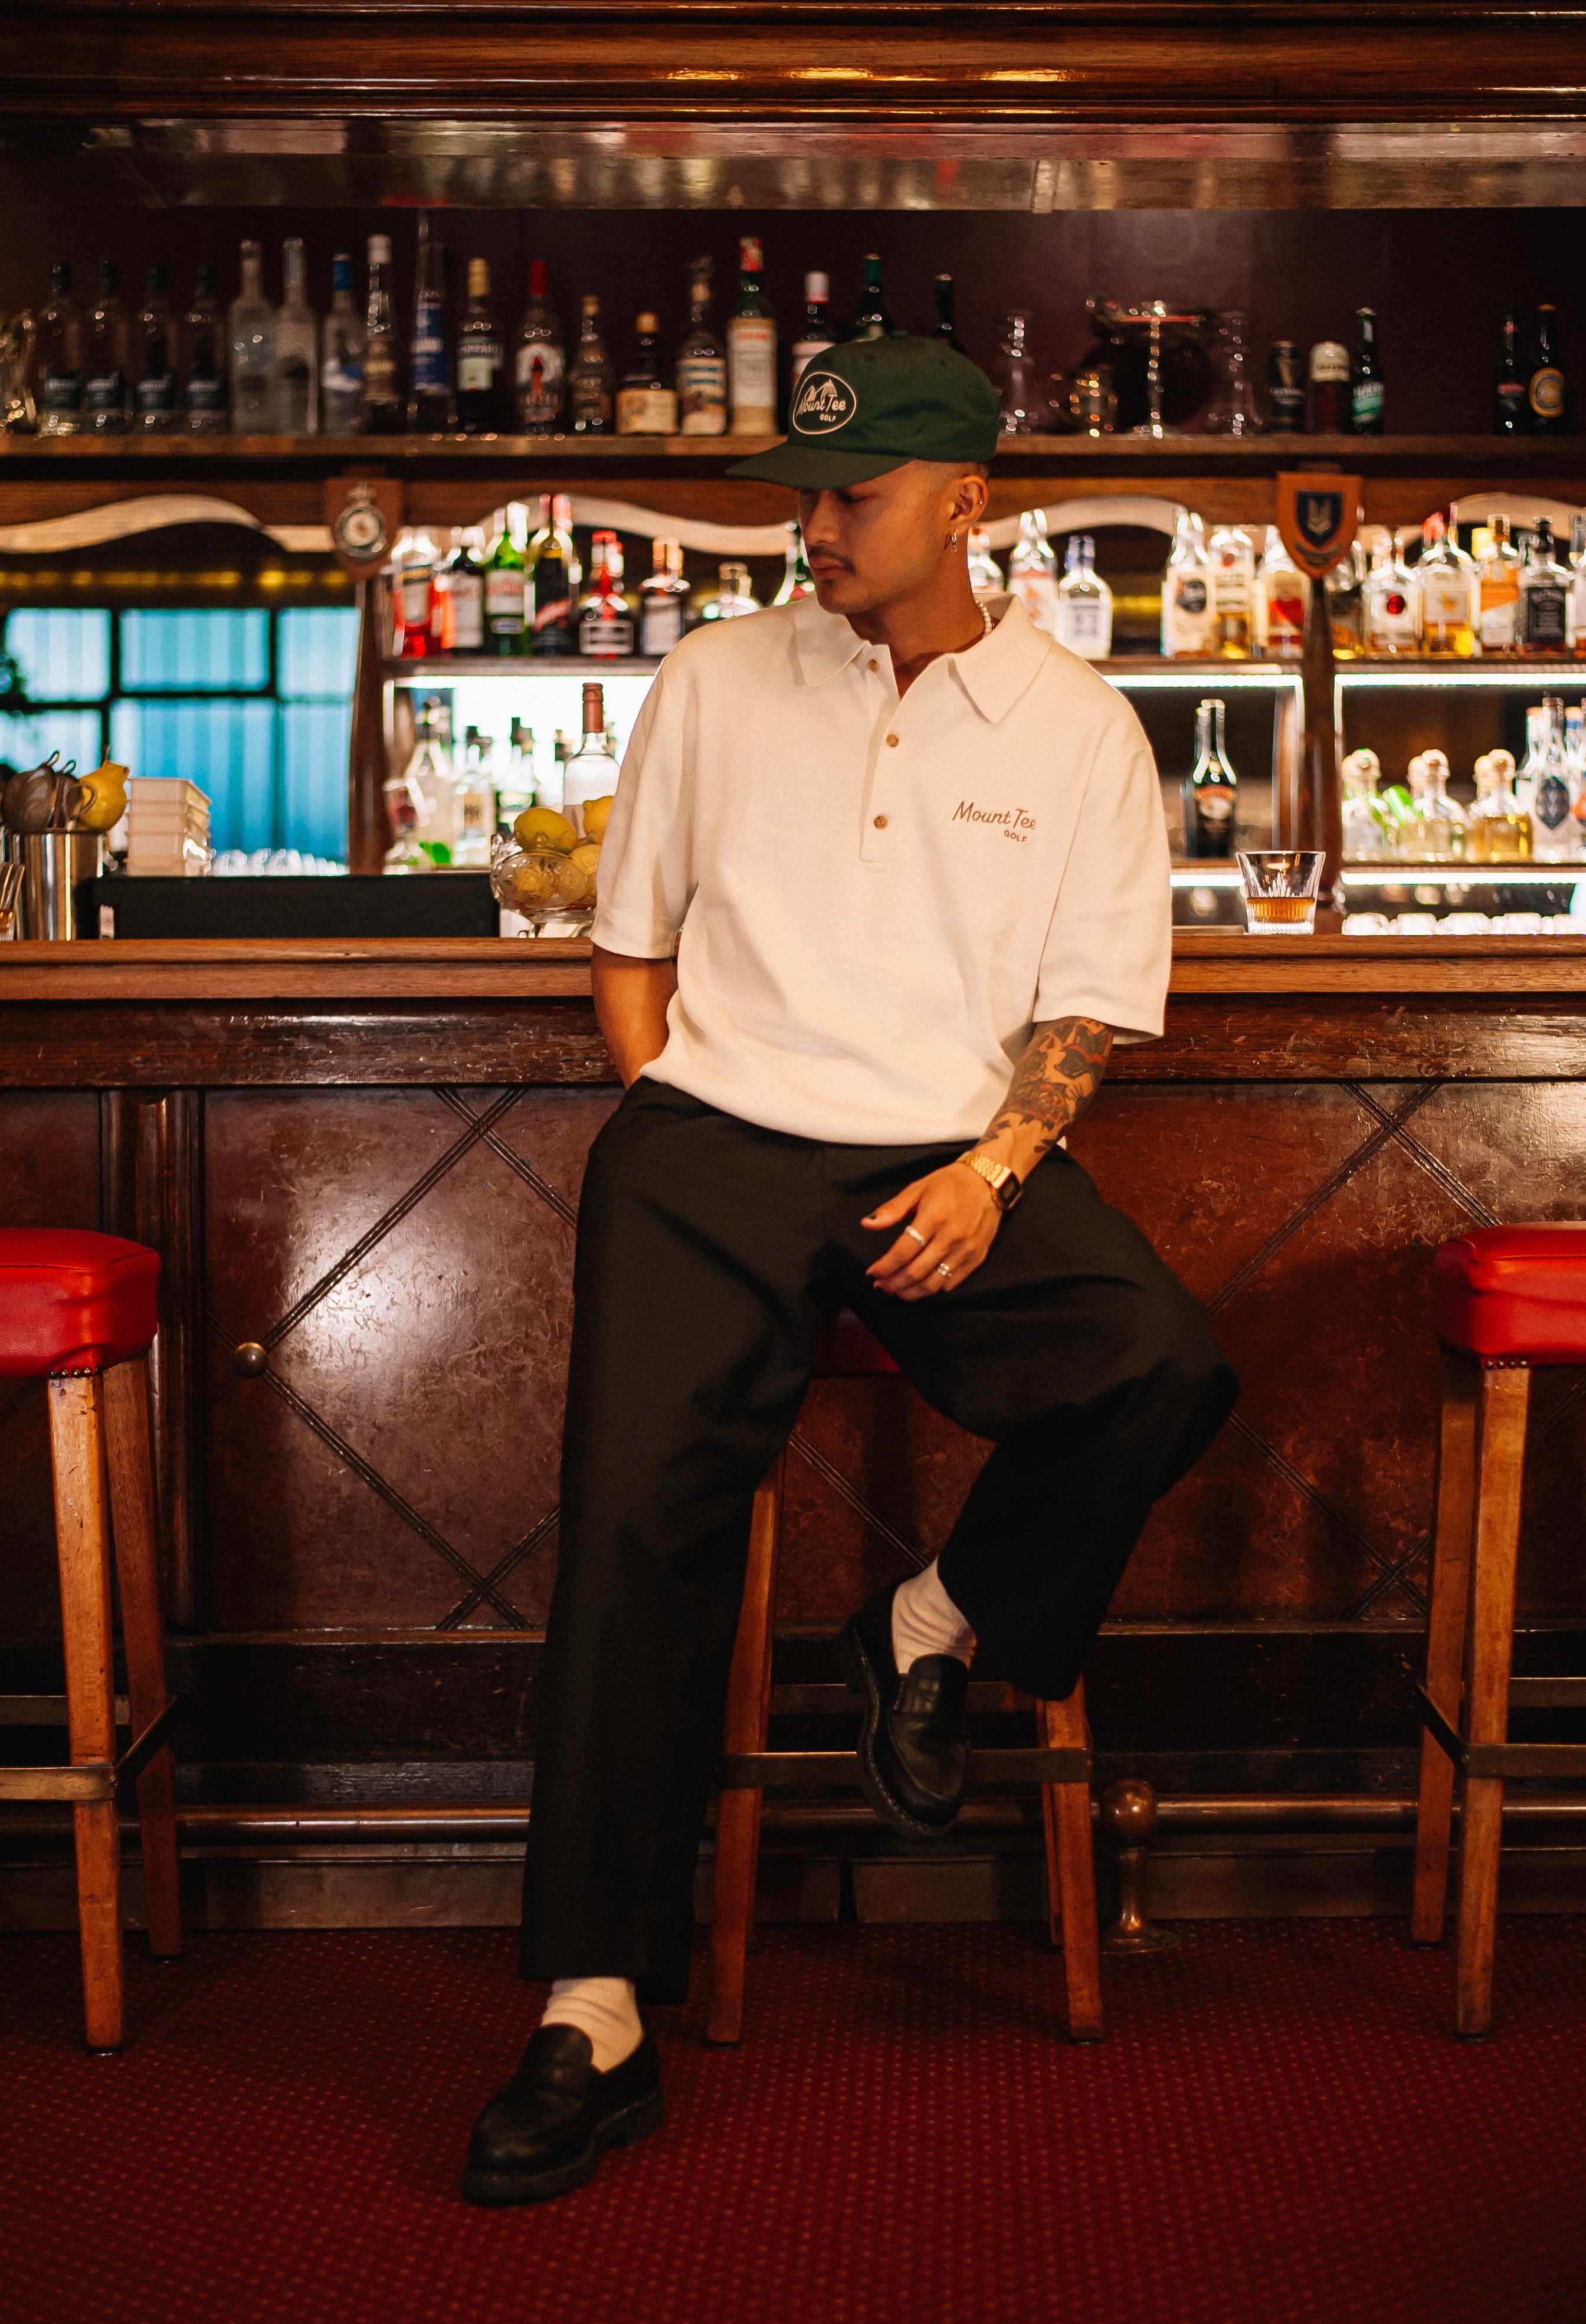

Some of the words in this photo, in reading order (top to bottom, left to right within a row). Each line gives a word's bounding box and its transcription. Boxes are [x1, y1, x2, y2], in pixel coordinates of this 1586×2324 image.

[796, 396, 825, 416] Mount
[826, 394, 846, 412] Tee
[952, 801, 1011, 824] Mount
[1013, 808, 1036, 830] Tee
[1004, 830, 1027, 843] GOLF
